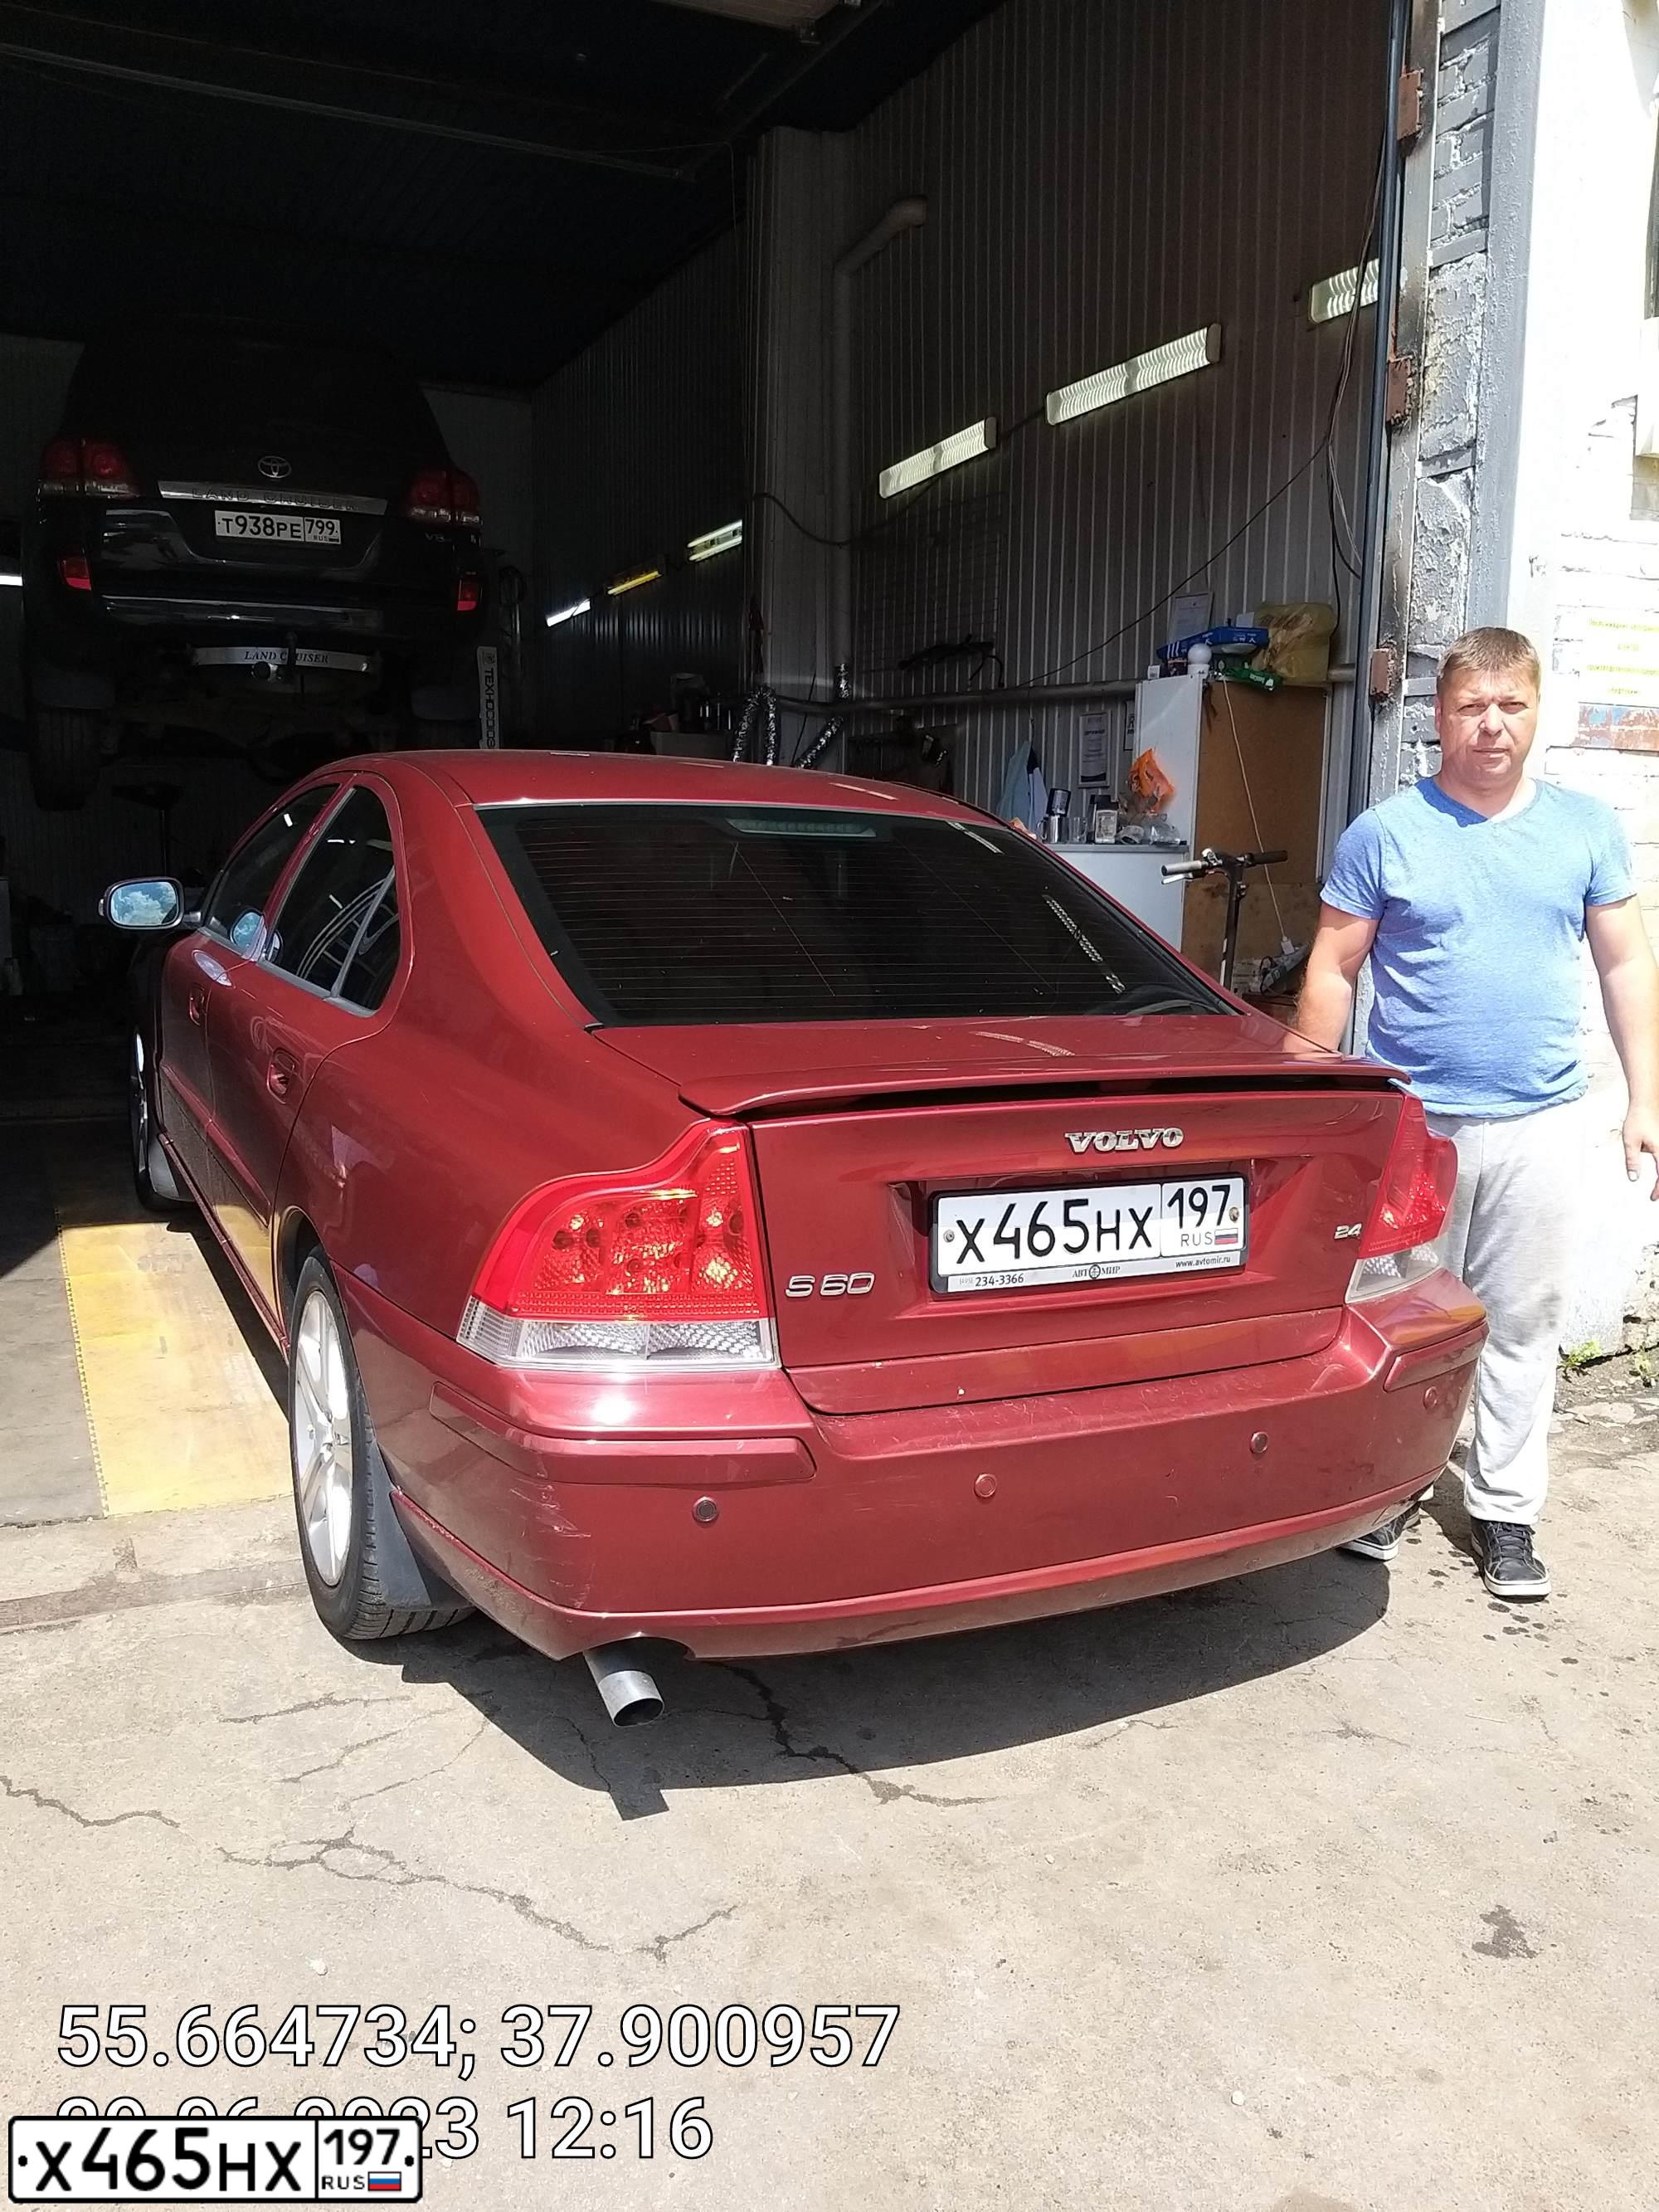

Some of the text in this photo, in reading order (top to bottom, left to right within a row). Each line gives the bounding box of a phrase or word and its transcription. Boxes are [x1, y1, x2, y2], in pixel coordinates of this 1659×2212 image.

[192, 489, 248, 502] LAND
[221, 515, 335, 539] Т938РЕ 799
[244, 650, 328, 664] LAND CUISER
[1064, 1128, 1185, 1153] VOLVO
[956, 1184, 1231, 1264] Х465НХ 197
[1180, 1231, 1213, 1247] RUS
[1175, 1255, 1231, 1268] www.avtomir.ru
[975, 1273, 1024, 1287] 234-3366
